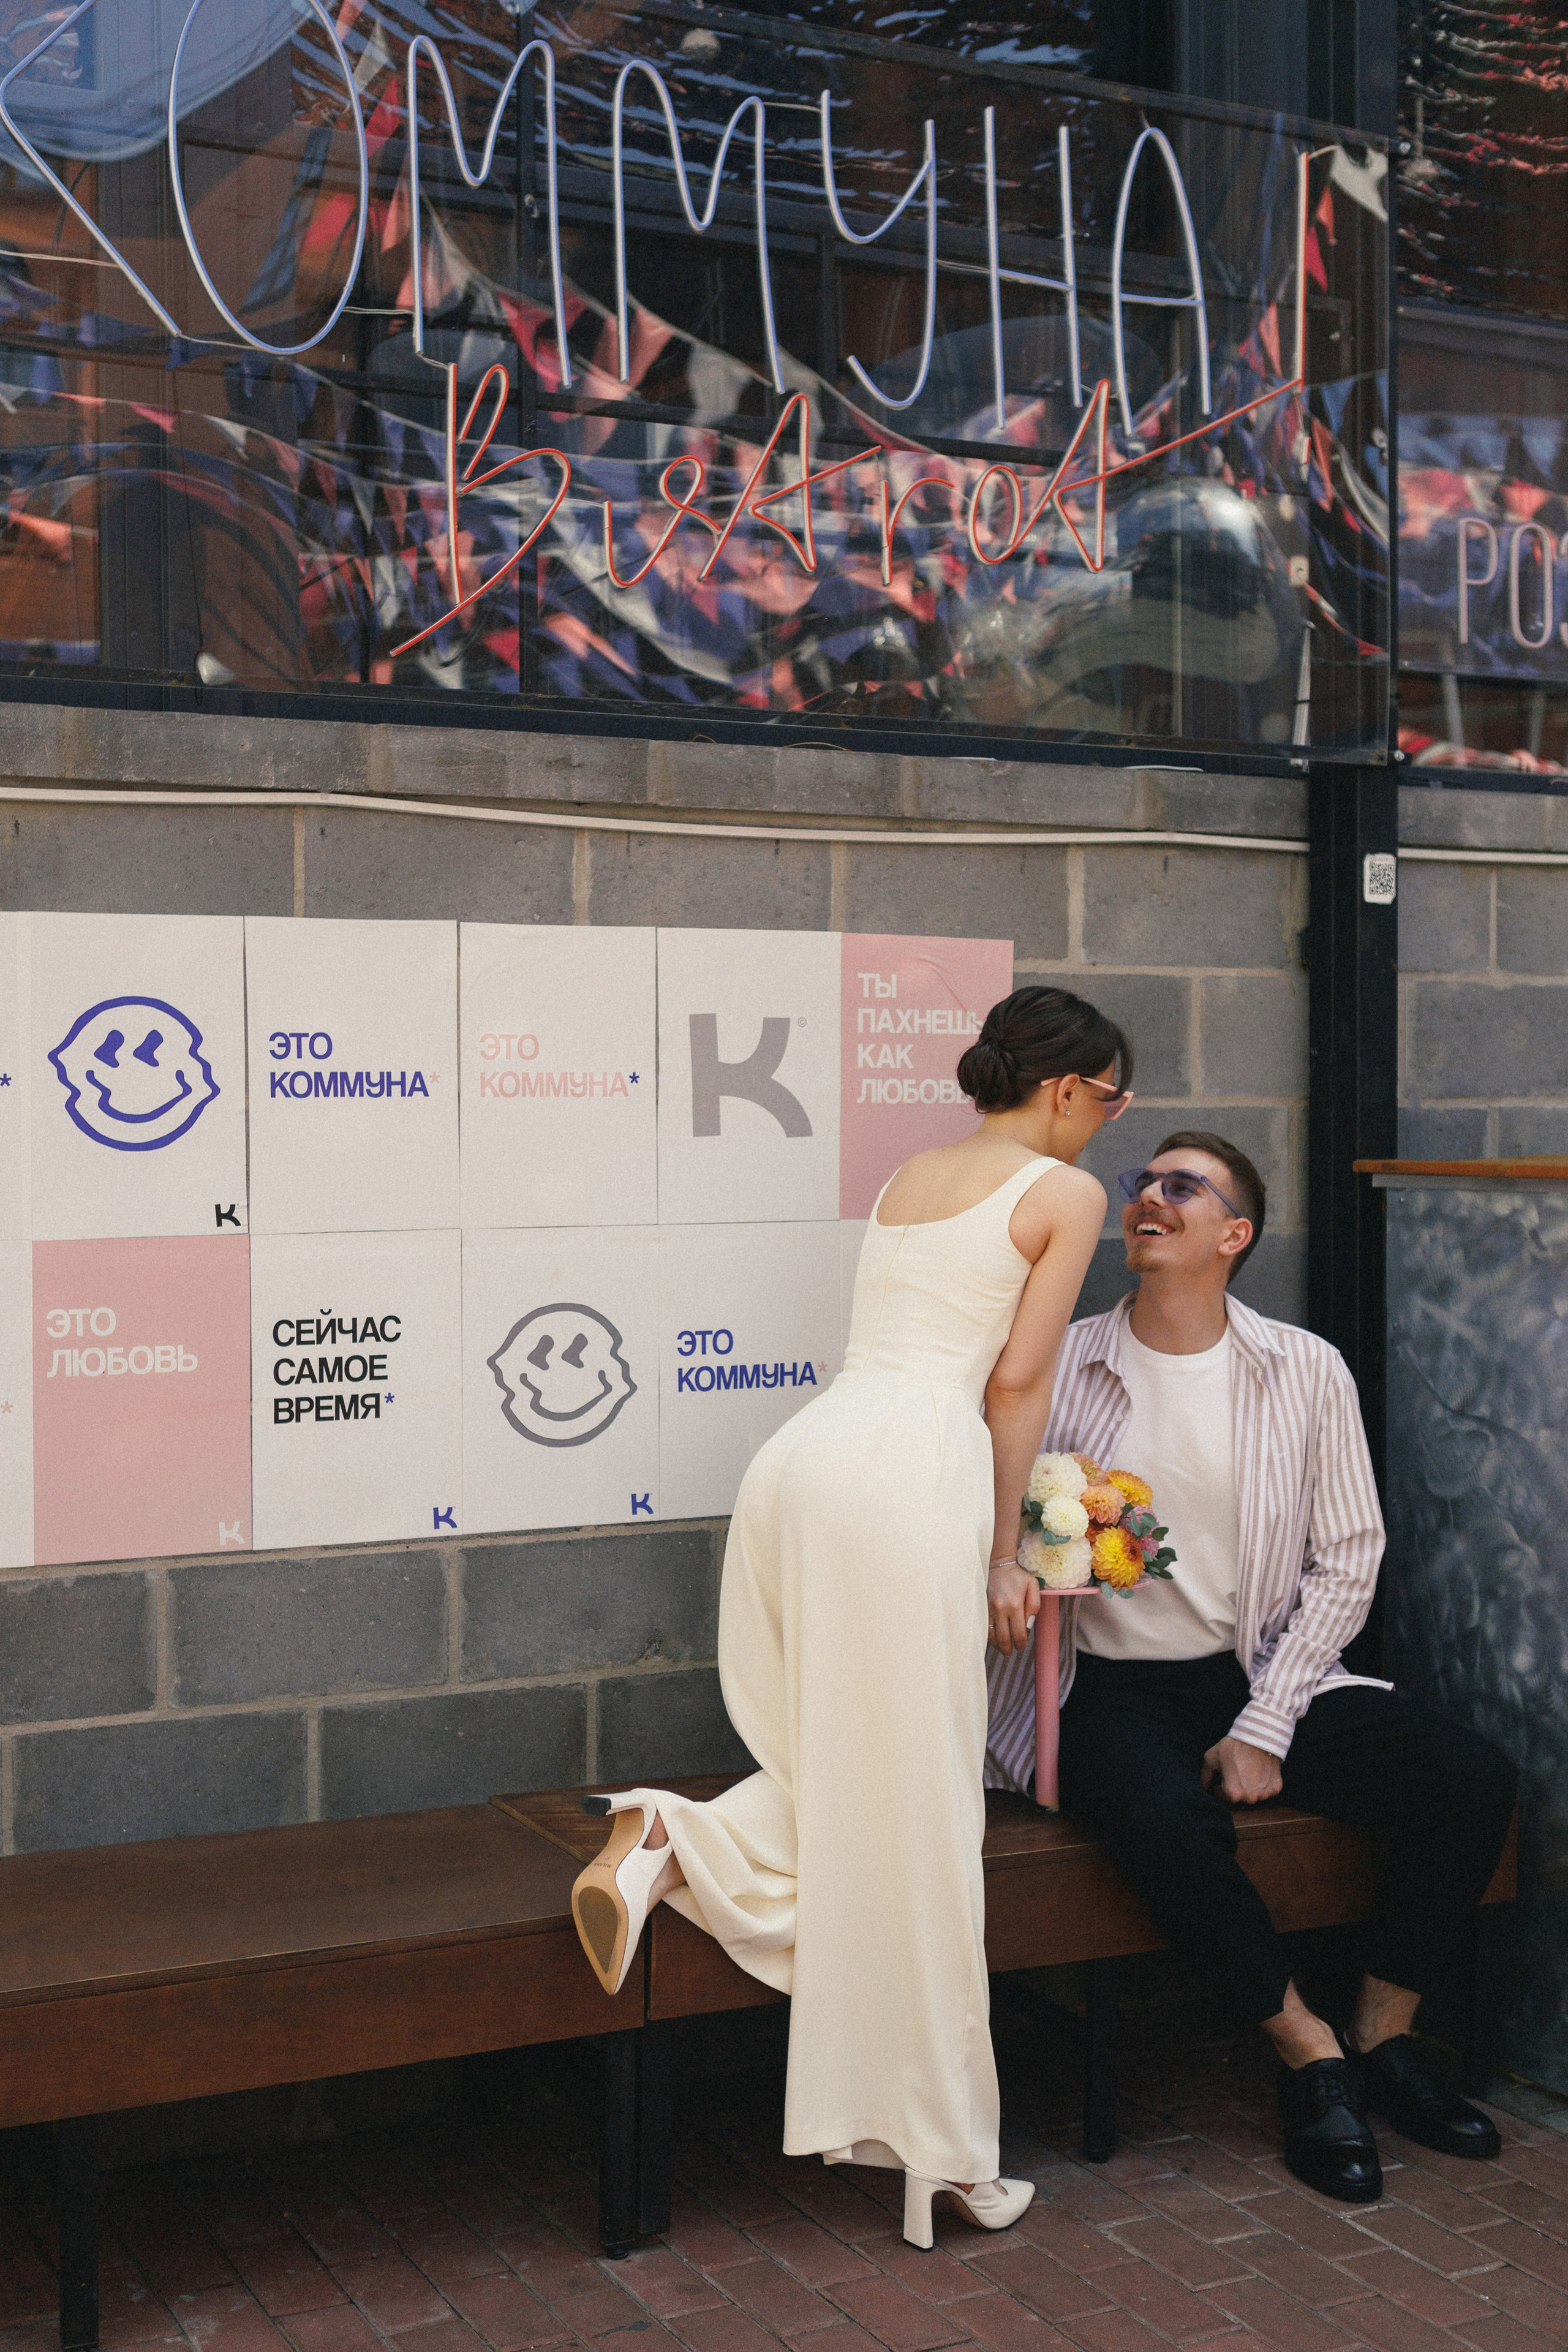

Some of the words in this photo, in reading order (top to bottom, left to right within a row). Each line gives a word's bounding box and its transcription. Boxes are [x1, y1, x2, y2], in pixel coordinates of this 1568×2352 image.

[1458, 517, 1568, 649] РО
[857, 972, 898, 999] ТЫ
[269, 1031, 333, 1060] ЭТО
[480, 1033, 540, 1061] ЭТО
[857, 1043, 914, 1069] КАК
[45, 1306, 117, 1338] ЭТО
[272, 1308, 401, 1348] СЕЙЧАС
[677, 1329, 734, 1357] ЭТО
[47, 1344, 198, 1378] ЛЮБОВЬ
[273, 1354, 388, 1386] САМОЕ
